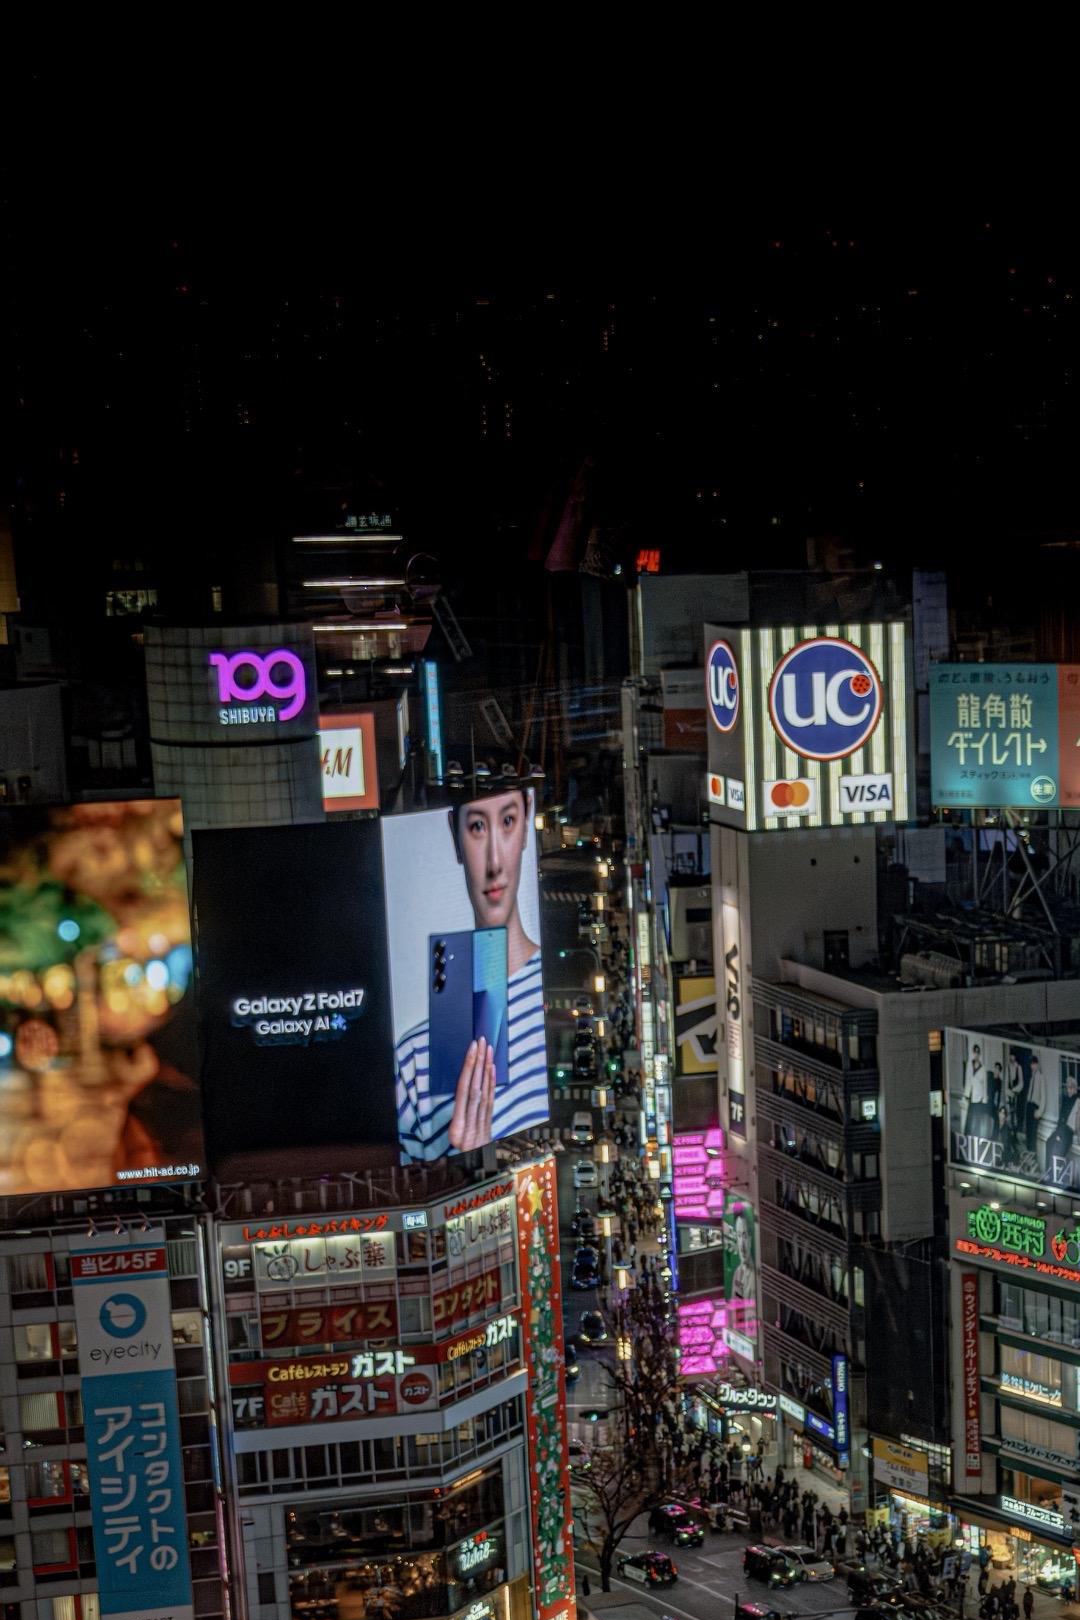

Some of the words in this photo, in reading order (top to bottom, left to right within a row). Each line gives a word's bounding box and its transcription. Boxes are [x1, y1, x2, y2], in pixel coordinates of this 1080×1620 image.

[209, 649, 306, 721] 109
[219, 706, 276, 725] SHIBUYA
[957, 693, 1033, 728] 龍角散
[947, 732, 1048, 766] ダイレクト
[730, 786, 744, 801] VISA
[843, 784, 890, 803] VISA
[233, 996, 302, 1016] Galaxy
[304, 993, 316, 1011] Z
[319, 989, 365, 1008] Fold7
[255, 1019, 313, 1036] Galaxy
[313, 1017, 330, 1031] AI
[730, 1101, 744, 1122] 7F
[955, 1132, 1005, 1169] RIIZE
[117, 1164, 200, 1180] www.hit-ad.co.jp
[1002, 1222, 1045, 1257] 西村
[81, 1252, 157, 1275] 当ビル5F
[224, 1260, 250, 1279] 9F
[303, 1240, 386, 1272] しゃぶ葉
[433, 1274, 498, 1321] コンタクト
[486, 1315, 518, 1346] ガスト
[90, 1340, 162, 1365] eyecity
[351, 1350, 415, 1378] ガスト
[311, 1384, 390, 1418] ガスト
[403, 1384, 431, 1397] ガスト
[720, 1383, 777, 1408] グルメタウン
[233, 1398, 264, 1419] 7F
[94, 1406, 144, 1574] アイシティ
[139, 1403, 178, 1571] コンタクトの
